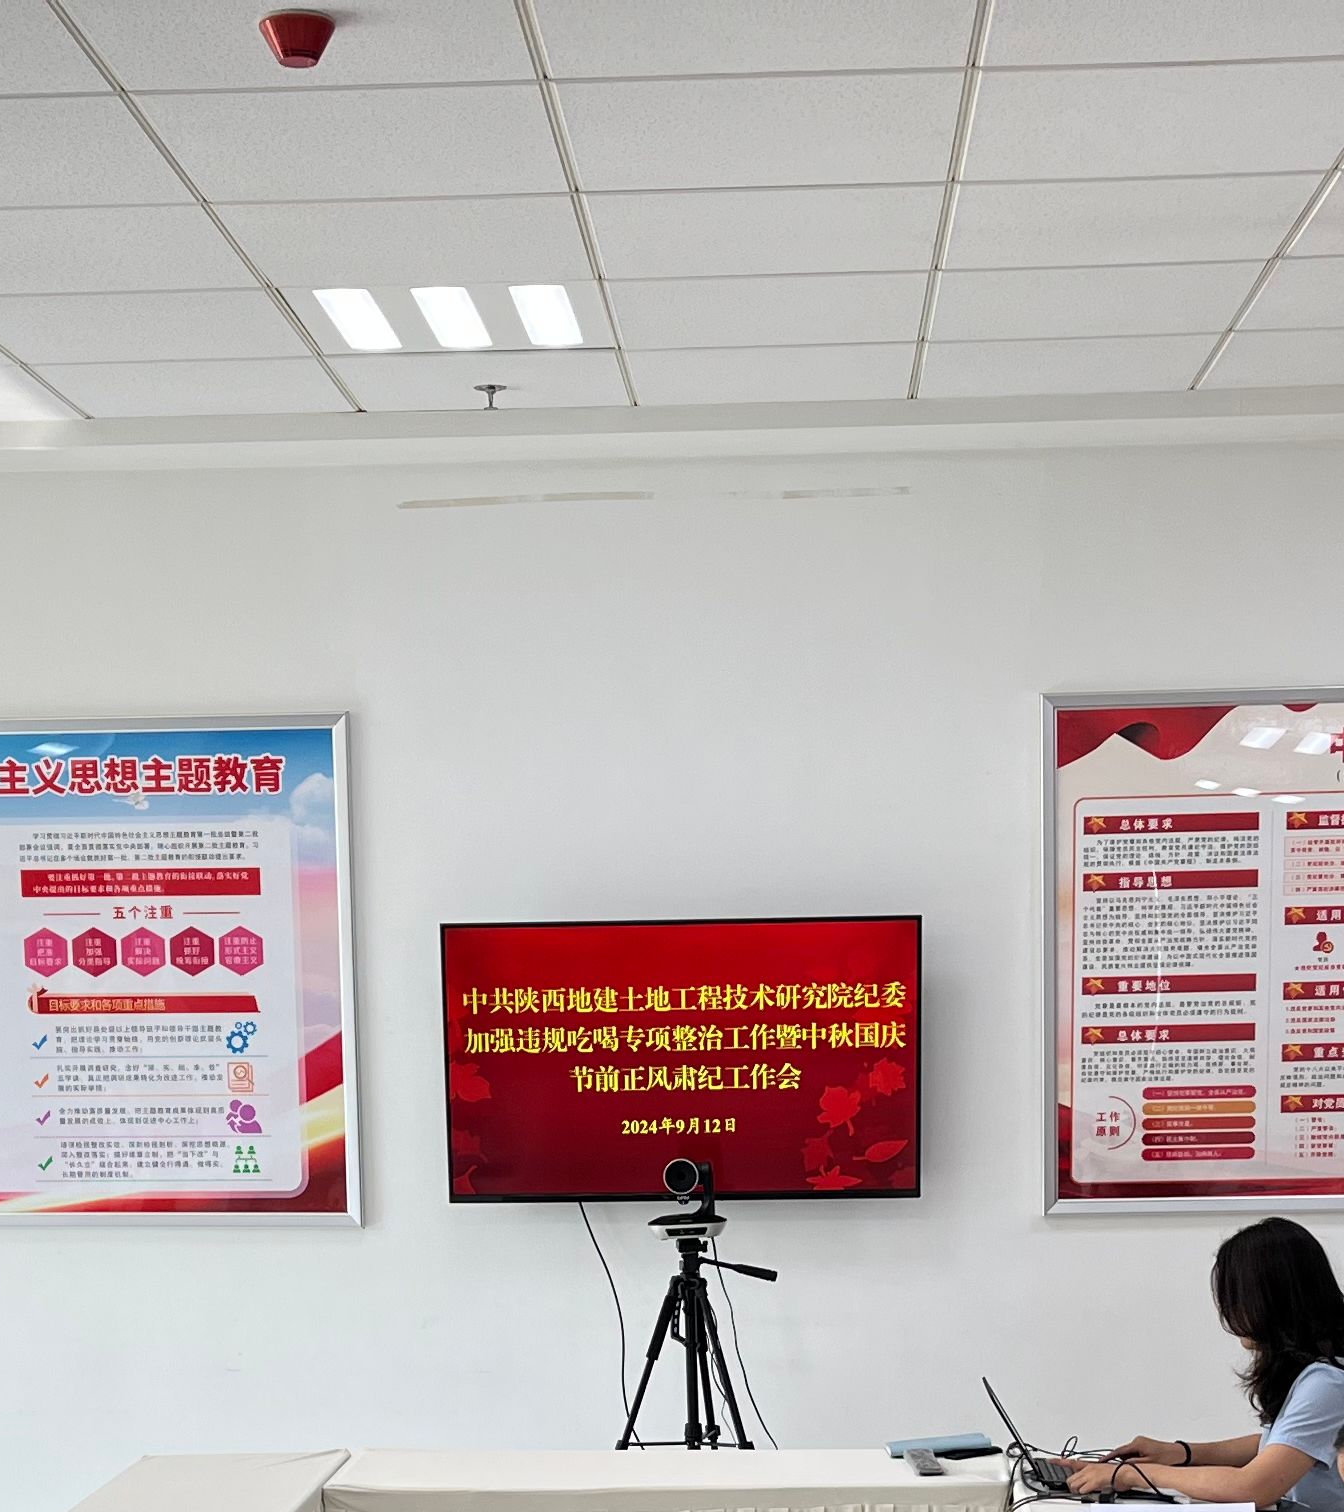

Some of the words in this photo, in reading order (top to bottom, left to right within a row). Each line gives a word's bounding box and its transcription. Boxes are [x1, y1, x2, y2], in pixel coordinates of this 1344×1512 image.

[1119, 817, 1174, 831] 总体要求
[1118, 875, 1173, 889] 指导思想
[113, 904, 173, 919] 五个注重
[1117, 980, 1171, 993] 重要地位
[462, 981, 907, 1015] 中共陕西地建土地工程技术研究院纪委
[464, 1022, 907, 1055] 加强违规吃喝专项整治工作暨中秋国庆
[569, 1062, 802, 1094] 节前正风肃纪工作会
[1096, 1112, 1121, 1123] 工作
[621, 1116, 737, 1136] 2024年9月12日
[1096, 1125, 1121, 1137] 原则
